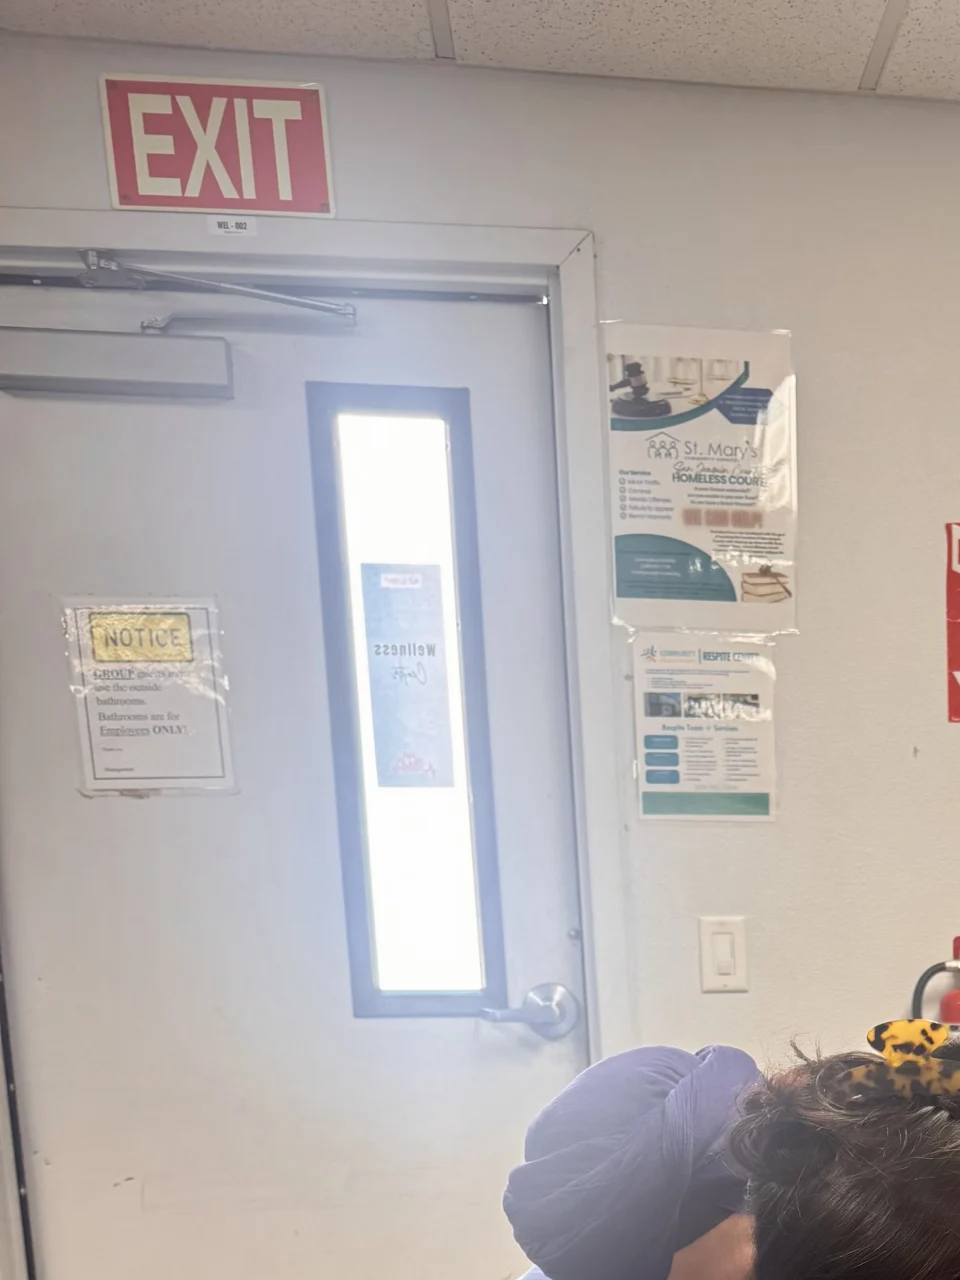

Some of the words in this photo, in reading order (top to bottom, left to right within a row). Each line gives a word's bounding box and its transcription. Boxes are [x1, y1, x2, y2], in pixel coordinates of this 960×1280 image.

[127, 93, 303, 201] EXIT
[683, 440, 703, 456] St.
[707, 440, 758, 460] Mary's
[672, 473, 727, 485] HOMELESS
[104, 627, 181, 649] NOTICE
[93, 669, 135, 681] GROUP
[98, 712, 148, 722] Bathrooms
[167, 711, 181, 721] for
[100, 726, 150, 737] Employees
